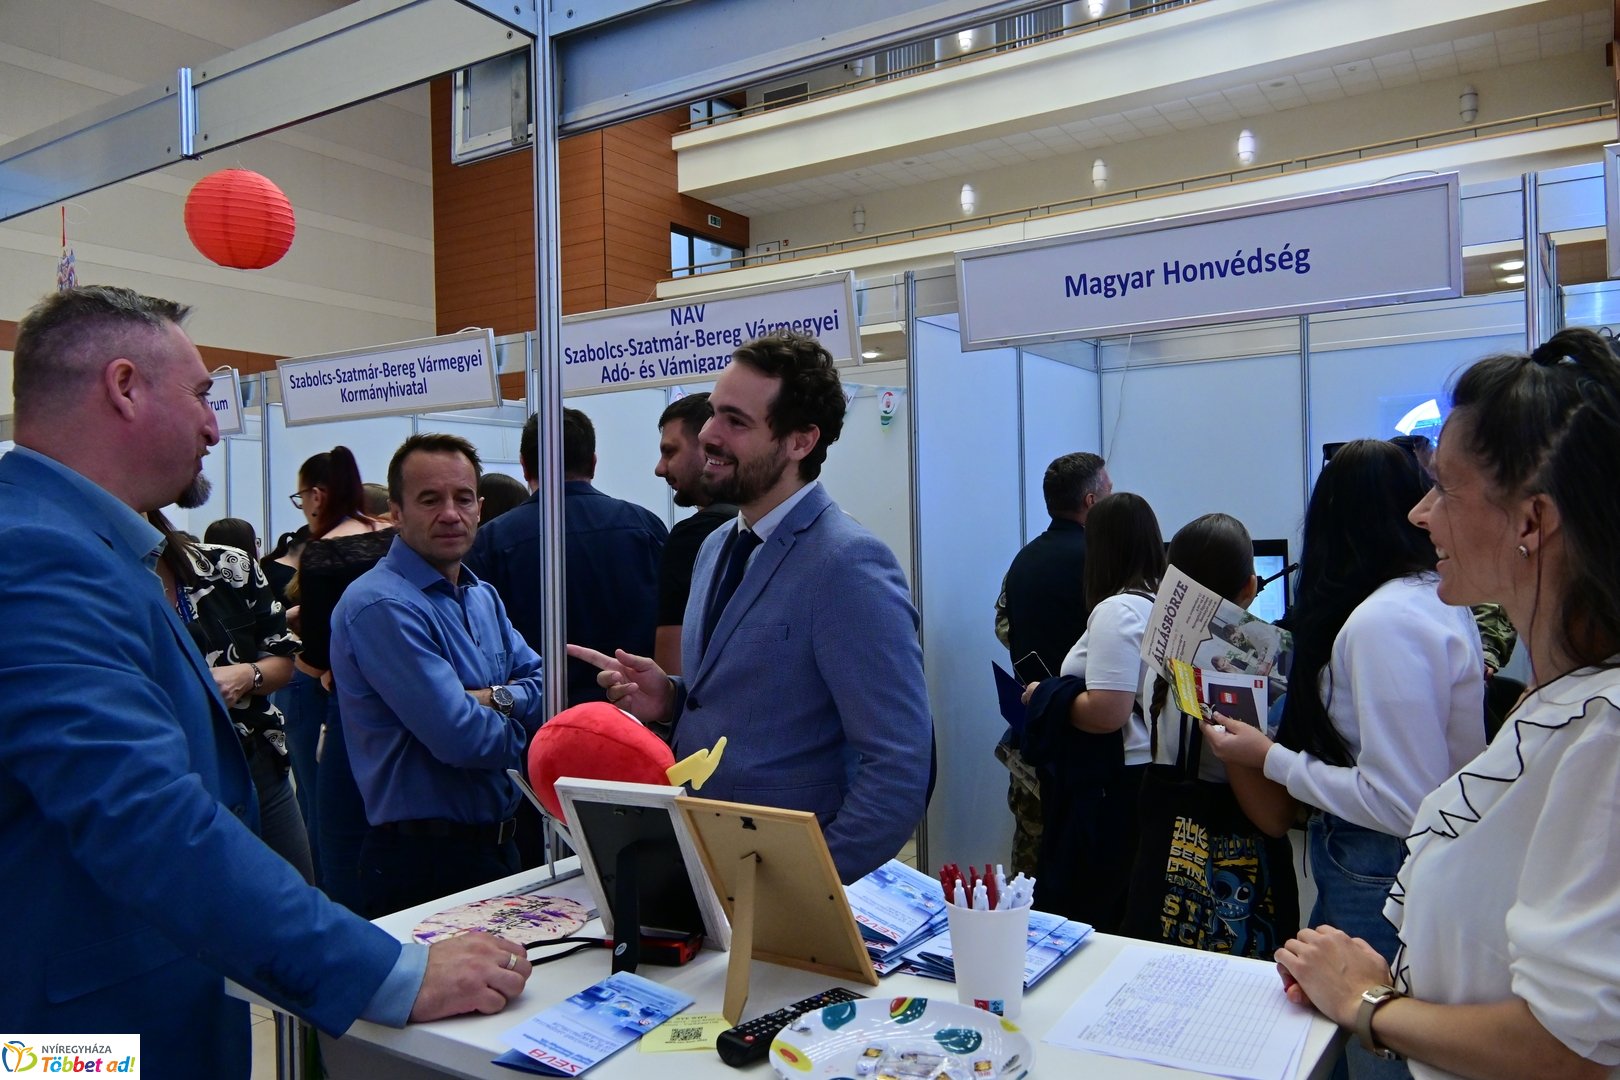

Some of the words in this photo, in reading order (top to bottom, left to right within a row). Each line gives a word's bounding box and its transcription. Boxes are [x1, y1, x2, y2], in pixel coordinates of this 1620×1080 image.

[1064, 268, 1155, 299] Magyar
[1163, 243, 1311, 285] Honvédség
[670, 303, 706, 327] NAV
[564, 327, 743, 365] Szabolcs-Szatmár-Bereg
[745, 308, 840, 340] Vármegyei
[289, 361, 416, 390] Szabolcs-Szatmár-Bereg
[417, 349, 483, 373] Vármegyei
[601, 360, 635, 384] Adó-
[639, 359, 656, 380] és
[658, 353, 733, 377] Vámigazg
[207, 398, 229, 411] rum
[340, 377, 428, 403] Kormányhivatal
[1152, 580, 1189, 667] ÁLLÁSBÖRZE
